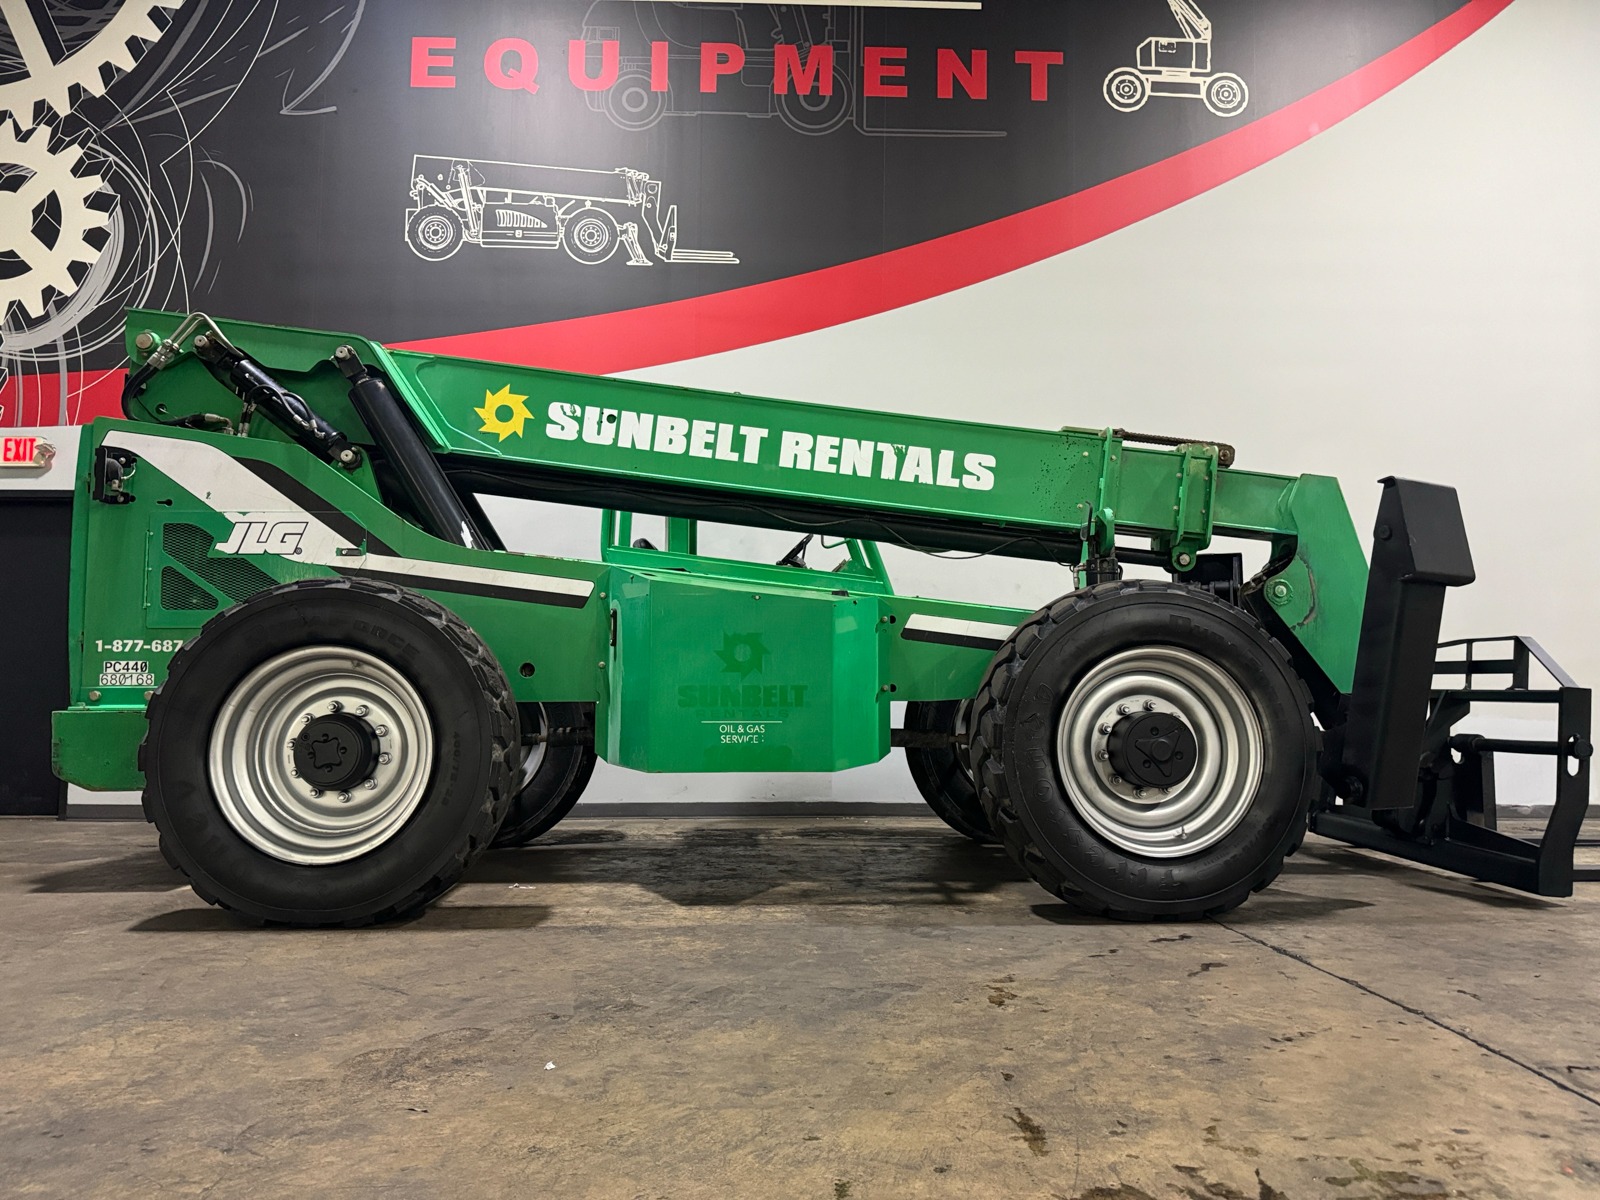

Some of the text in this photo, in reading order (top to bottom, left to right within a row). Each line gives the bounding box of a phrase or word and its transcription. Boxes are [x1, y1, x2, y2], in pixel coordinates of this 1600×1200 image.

[409, 36, 1065, 103] EQUIPMENT
[3, 437, 37, 462] EXIT
[545, 401, 997, 492] SUNBELT RENTALS
[214, 521, 309, 555] JLG
[95, 639, 183, 653] 1-877-687
[104, 661, 148, 673] PC440
[100, 674, 154, 686] 680168
[677, 684, 808, 708] SUNBELT
[719, 724, 766, 734] OIL & GAS
